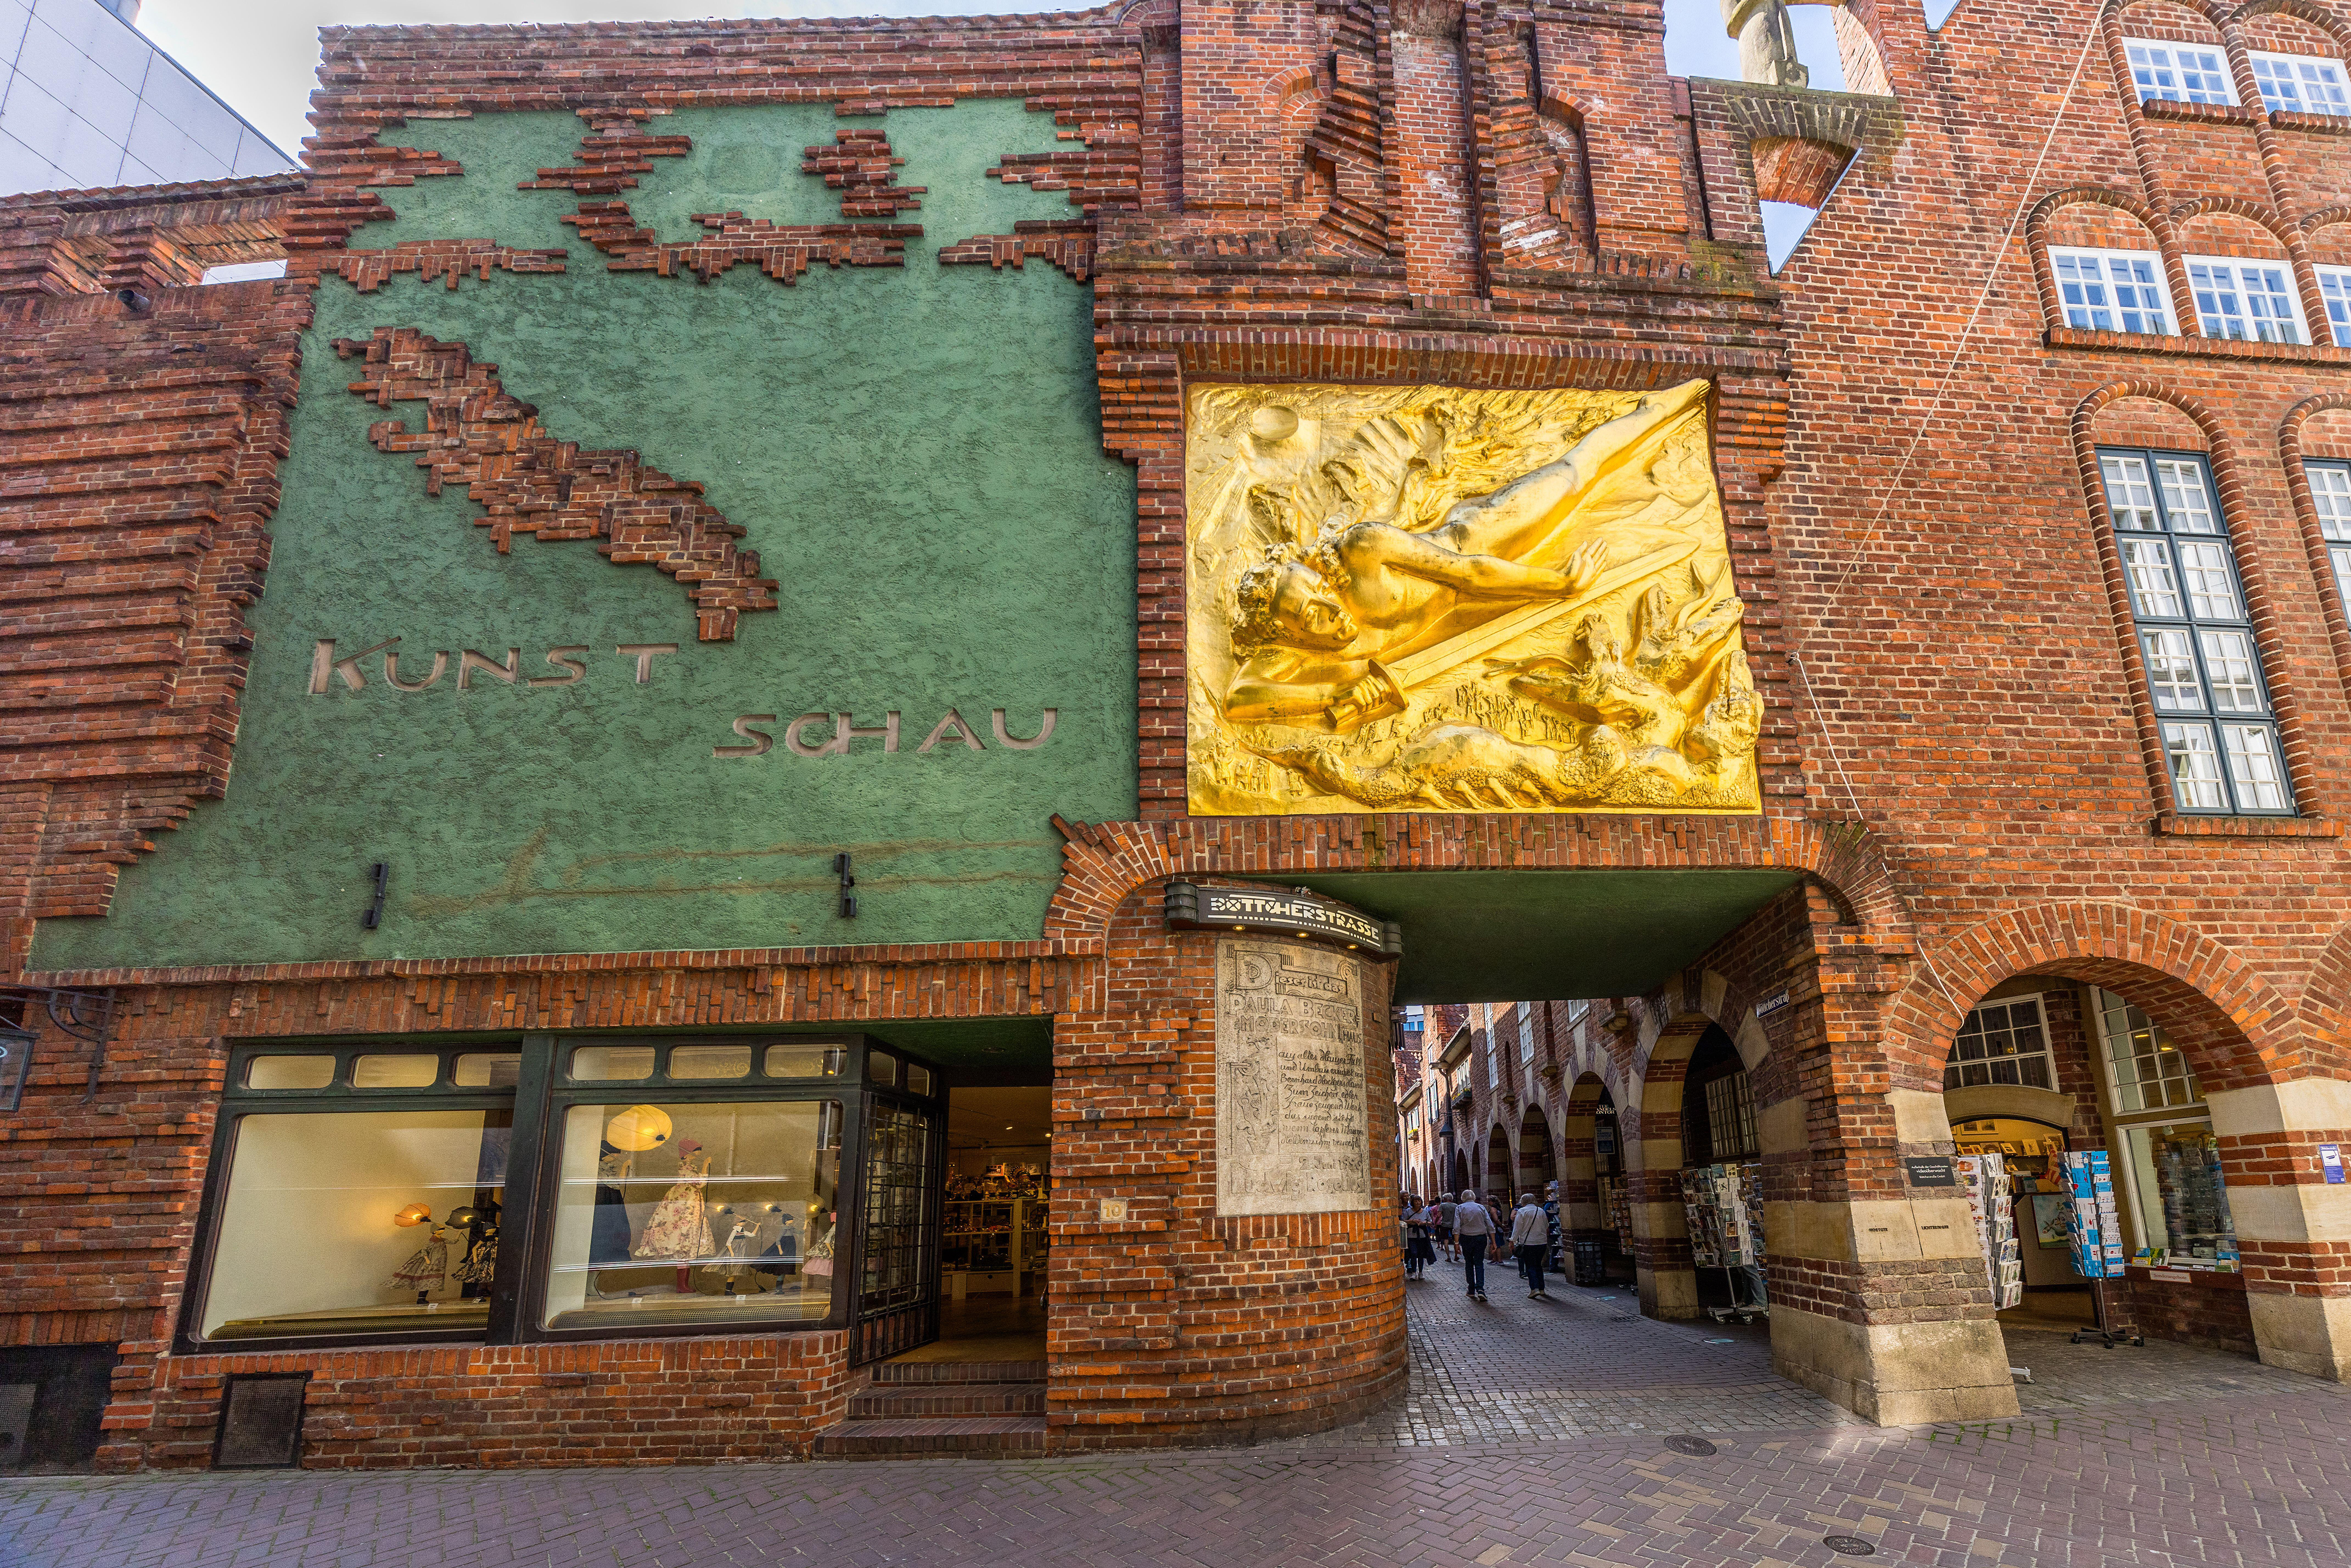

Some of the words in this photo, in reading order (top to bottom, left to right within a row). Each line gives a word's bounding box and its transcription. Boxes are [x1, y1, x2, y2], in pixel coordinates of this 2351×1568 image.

[309, 636, 679, 694] KUNST
[713, 707, 1058, 757] SCHAU
[1210, 897, 1379, 940] BÖTTCHERSTRASSE
[1308, 975, 1321, 989] ist
[1323, 977, 1343, 993] das
[1229, 993, 1293, 1016] PAULA
[1298, 998, 1358, 1025] BECKER
[1756, 989, 1789, 1015] Böttcherstraß
[1240, 1015, 1341, 1041] MODERSOHN
[1343, 1030, 1362, 1043] HAUS
[1298, 1050, 1318, 1060] alter
[1346, 1054, 1362, 1066] Fall
[1280, 1061, 1297, 1071] und
[1299, 1061, 1329, 1073] Umbau
[1330, 1067, 1354, 1077] errichtet
[1354, 1071, 1364, 1081] von
[1280, 1073, 1318, 1085] Bernhard
[1318, 1074, 1345, 1090] Hoetgers
[1345, 1077, 1363, 1089] Hand
[1284, 1084, 1309, 1099] Zum
[1308, 1085, 1338, 1101] Zeichen
[1341, 1089, 1358, 1099] edler
[1344, 1099, 1363, 1112] Werk
[1284, 1110, 1300, 1122] das
[1300, 1110, 1332, 1124] siegend
[1332, 1112, 1354, 1125] steht
[1310, 1122, 1339, 1137] tapferer
[1281, 1132, 1330, 1149] Heldenruhm
[1314, 1156, 1336, 1170] Juni
[1231, 1171, 1305, 1200] Ludwig
[1306, 1171, 1365, 1194] Roselius
[1103, 1203, 1122, 1218] 10
